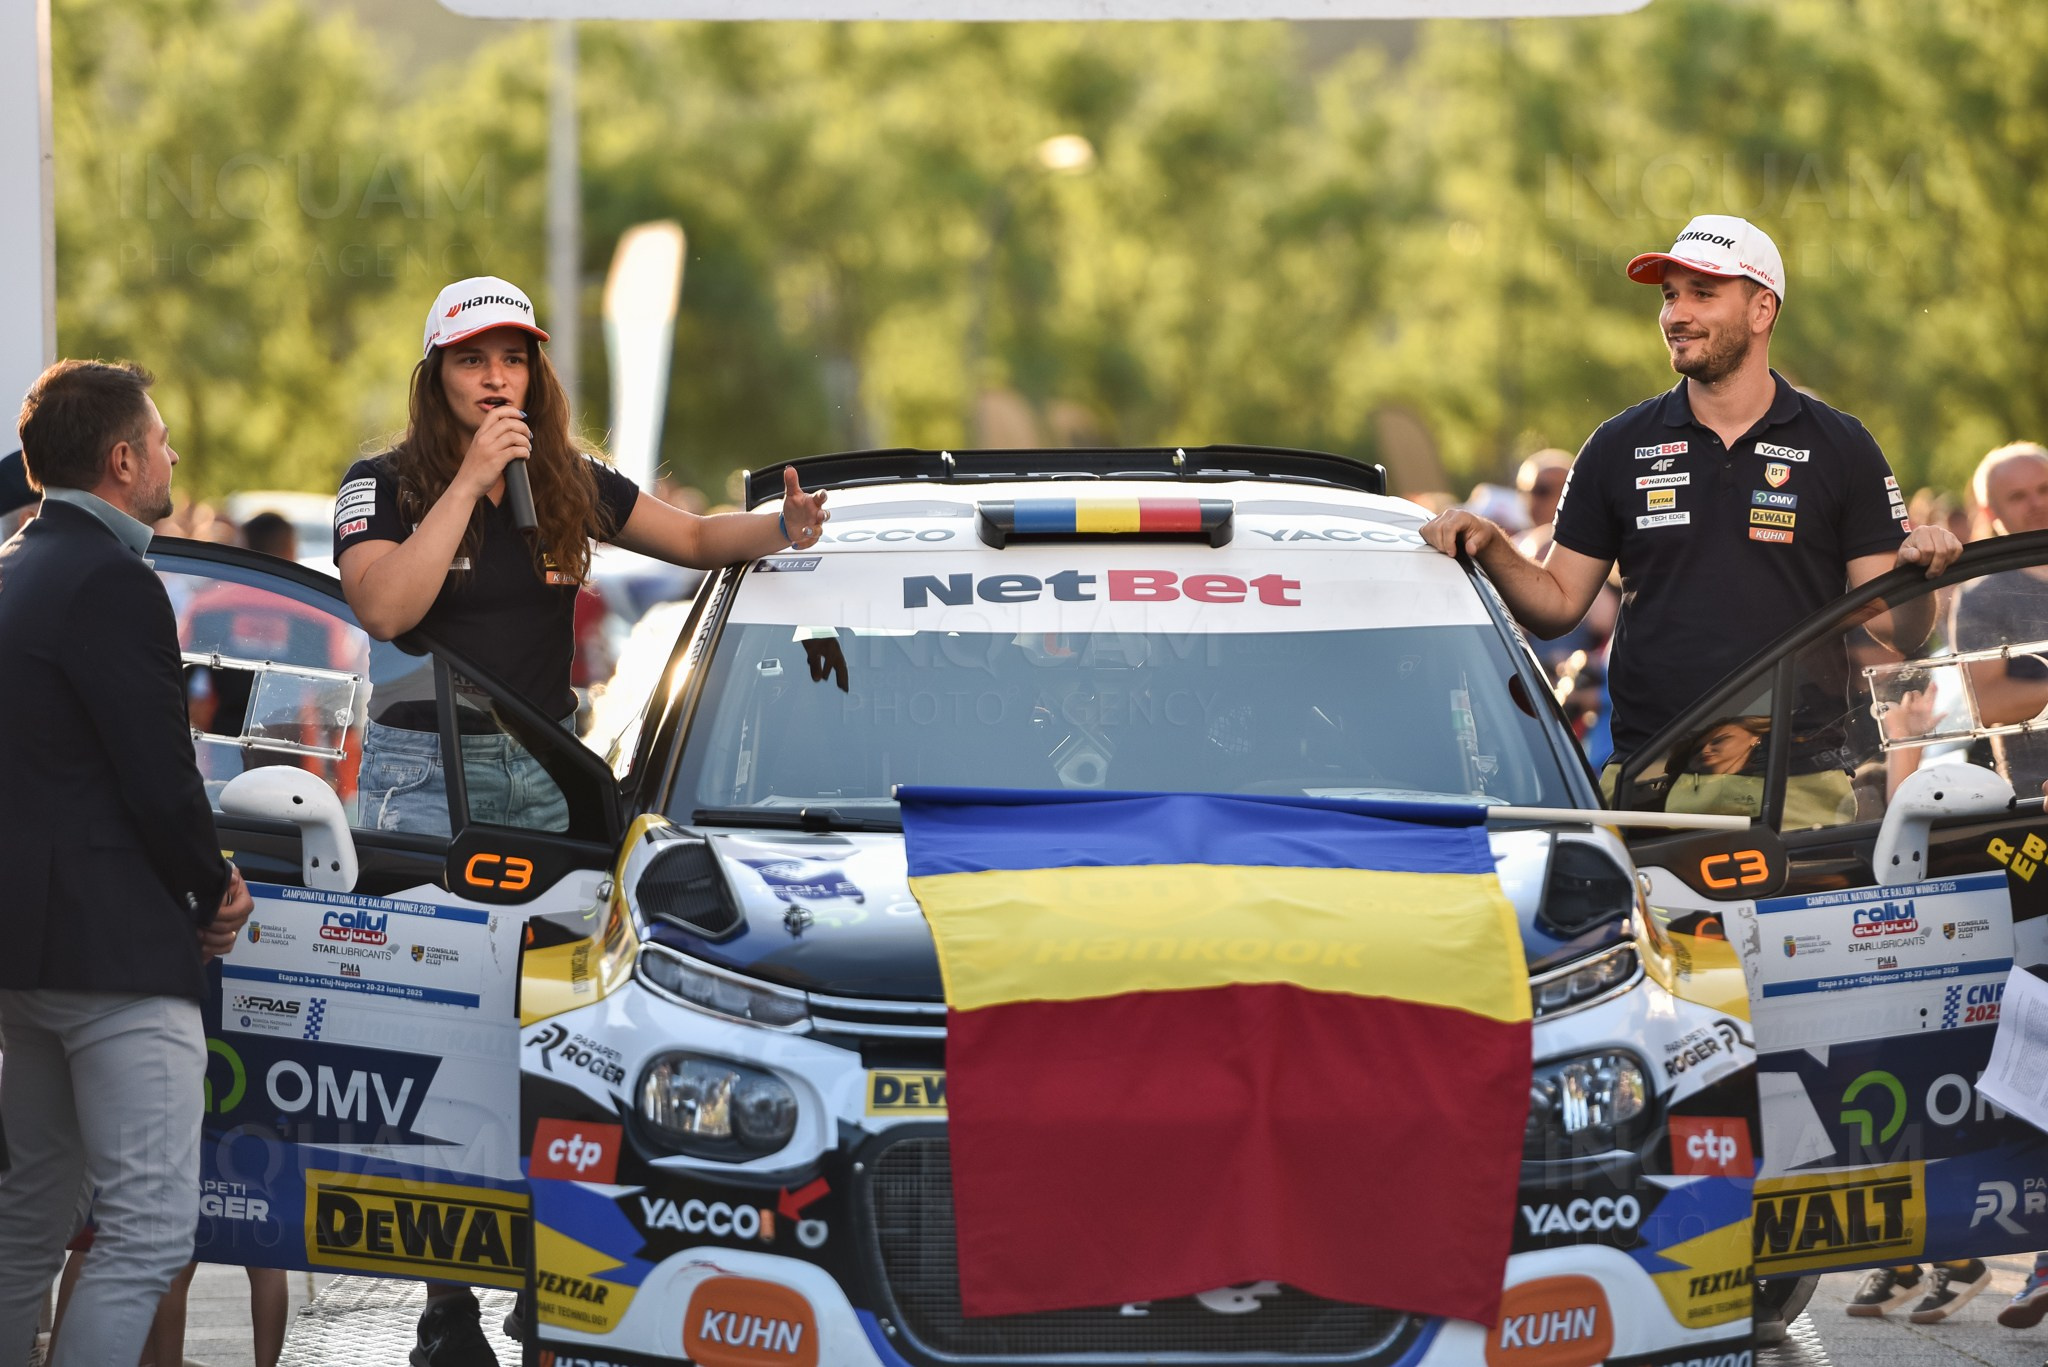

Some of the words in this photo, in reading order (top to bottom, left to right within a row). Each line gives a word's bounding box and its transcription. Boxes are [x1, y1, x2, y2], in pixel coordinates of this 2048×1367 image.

[1636, 443, 1687, 457] NetBet
[1761, 444, 1805, 460] YACCO
[1651, 459, 1675, 471] 4F
[1771, 467, 1785, 477] BT
[1649, 497, 1674, 505] TEXTAR
[1769, 494, 1794, 505] OMV
[1755, 529, 1787, 541] KUHN
[902, 568, 1302, 609] NetBet
[465, 853, 534, 890] C3
[1700, 849, 1769, 889] C3
[282, 888, 326, 902] CAMPIONATUL
[327, 894, 358, 906] NATIONAL
[358, 898, 367, 907] DE
[368, 899, 393, 910] RALIURI
[394, 902, 418, 913] WINNER
[419, 905, 436, 915] 2025
[1957, 919, 1989, 928] CONSILIUL
[1957, 932, 1973, 940] CLUJ
[426, 946, 459, 956] CONSILIUL
[278, 973, 297, 983] Etapa
[305, 976, 315, 984] 3-a
[320, 979, 361, 990] Cluj-Napoca
[366, 983, 385, 992] 20-22
[387, 985, 404, 994] iunie
[406, 988, 423, 997] 2025
[246, 996, 301, 1014] FRAS
[560, 1043, 626, 1086] ROGER
[1664, 1037, 1721, 1080] ROGER
[266, 1060, 414, 1128] OMV
[548, 1133, 602, 1173] ctp
[1687, 1128, 1737, 1167] ctp
[200, 1194, 269, 1222] GER
[638, 1195, 761, 1239] YACCO
[1521, 1194, 1641, 1236] YACCO
[536, 1269, 609, 1305] TEXTAR
[700, 1308, 803, 1354] KUHN
[1501, 1305, 1597, 1349] KUHN
